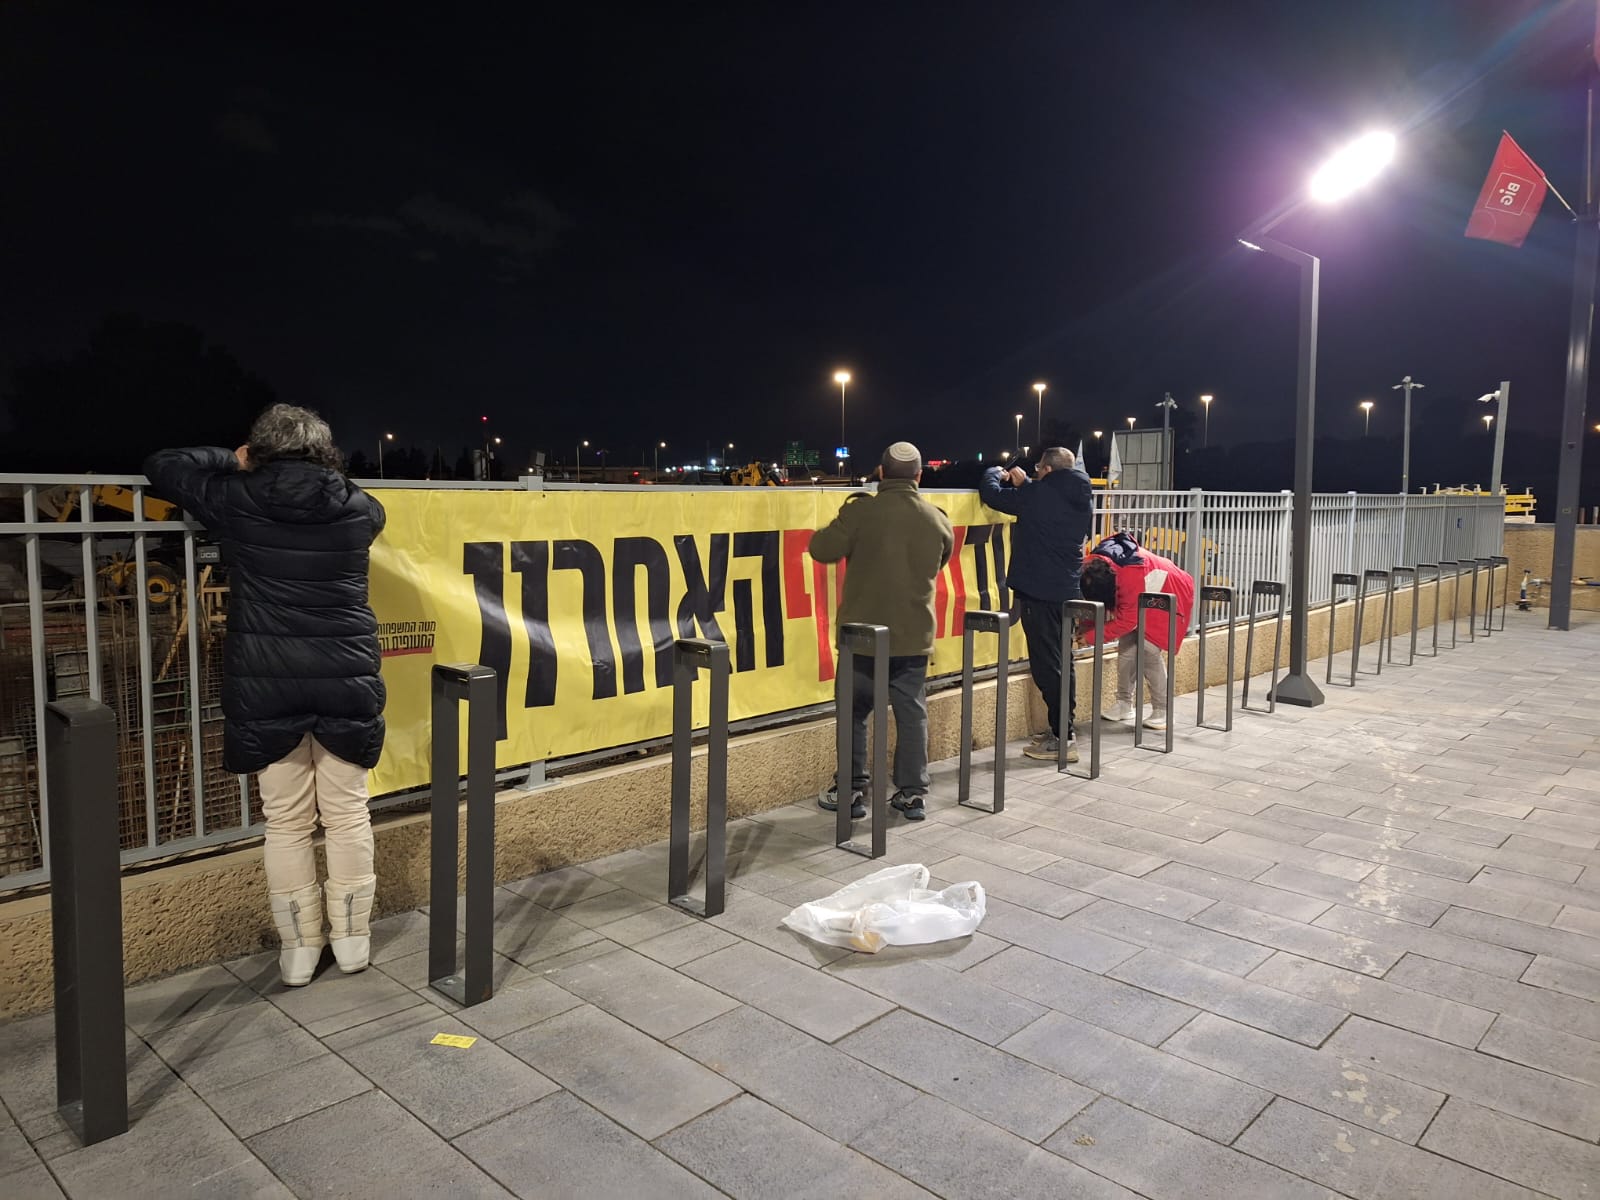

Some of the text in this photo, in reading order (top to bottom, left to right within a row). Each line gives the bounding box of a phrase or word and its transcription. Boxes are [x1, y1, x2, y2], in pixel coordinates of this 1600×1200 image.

[419, 621, 436, 632] מטה
[392, 634, 434, 650] החטופים
[463, 530, 784, 741] האחרון
